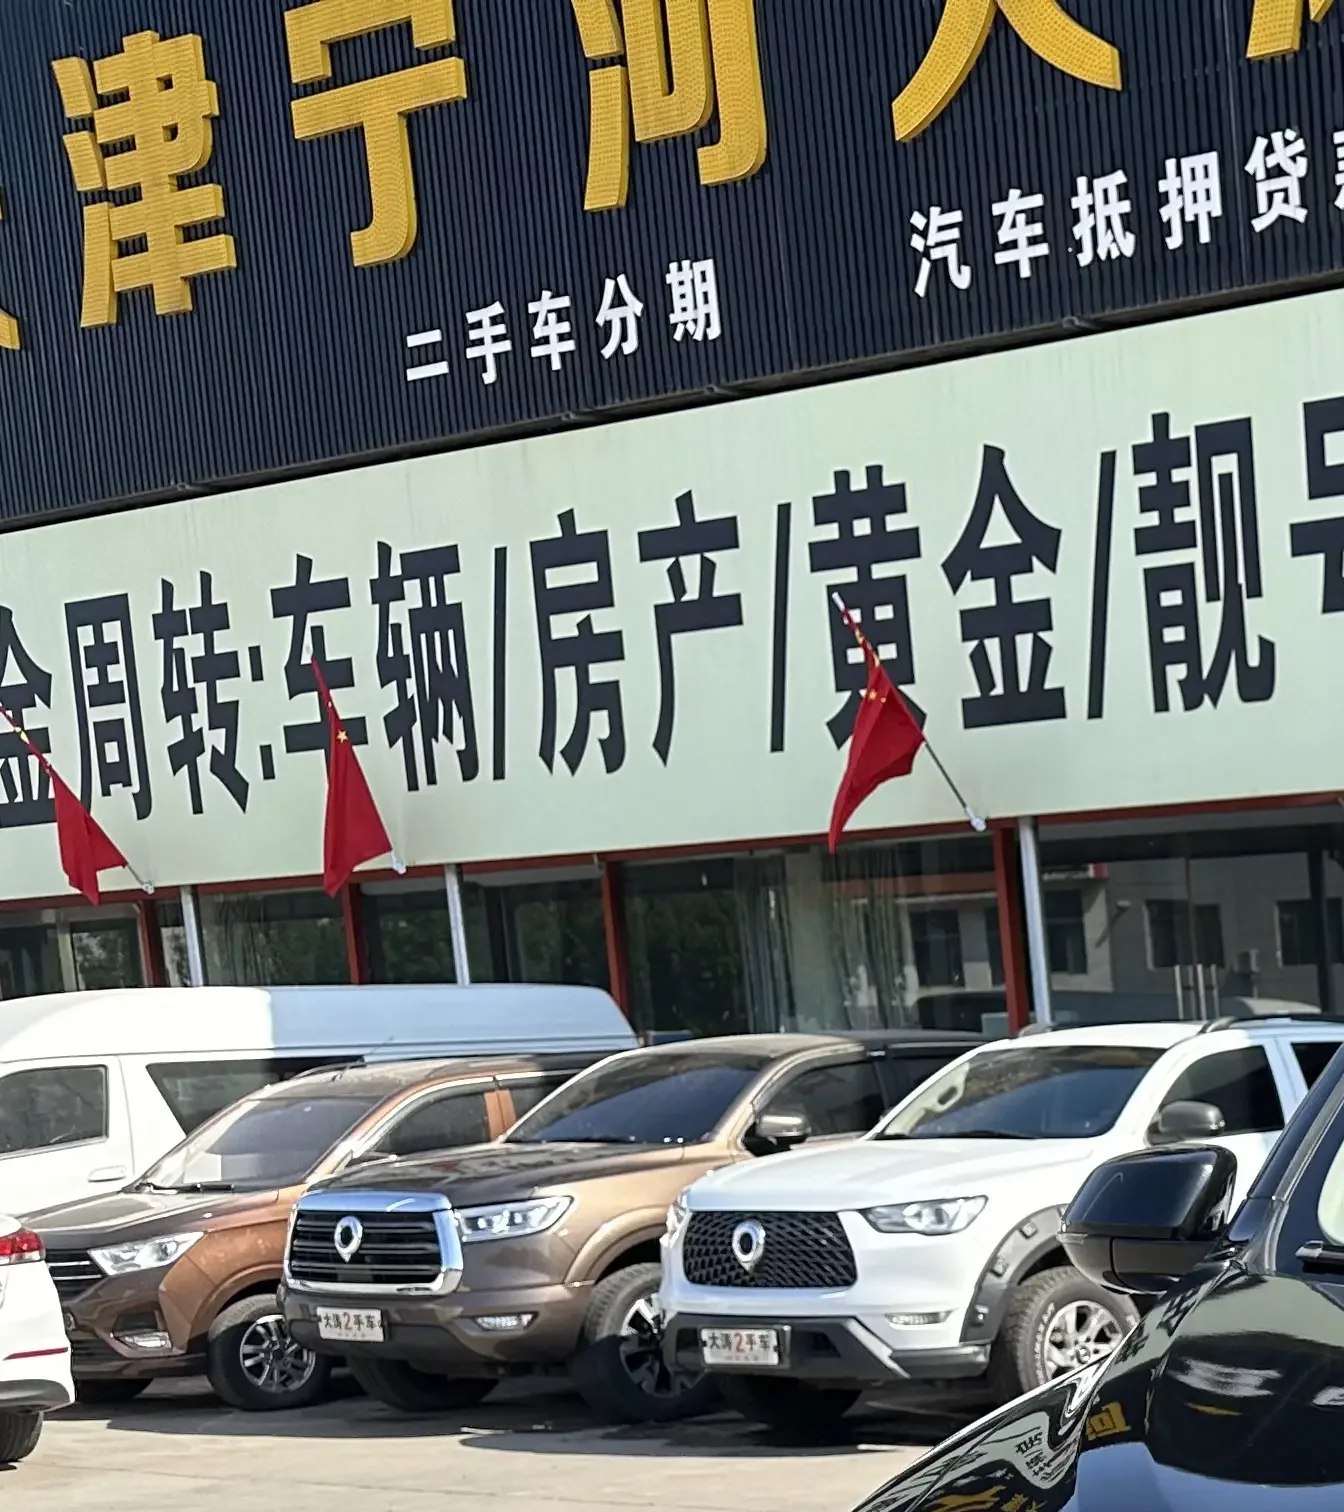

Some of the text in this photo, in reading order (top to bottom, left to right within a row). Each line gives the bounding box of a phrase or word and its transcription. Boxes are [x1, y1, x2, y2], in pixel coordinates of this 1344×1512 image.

[405, 258, 722, 385] 二手车分期
